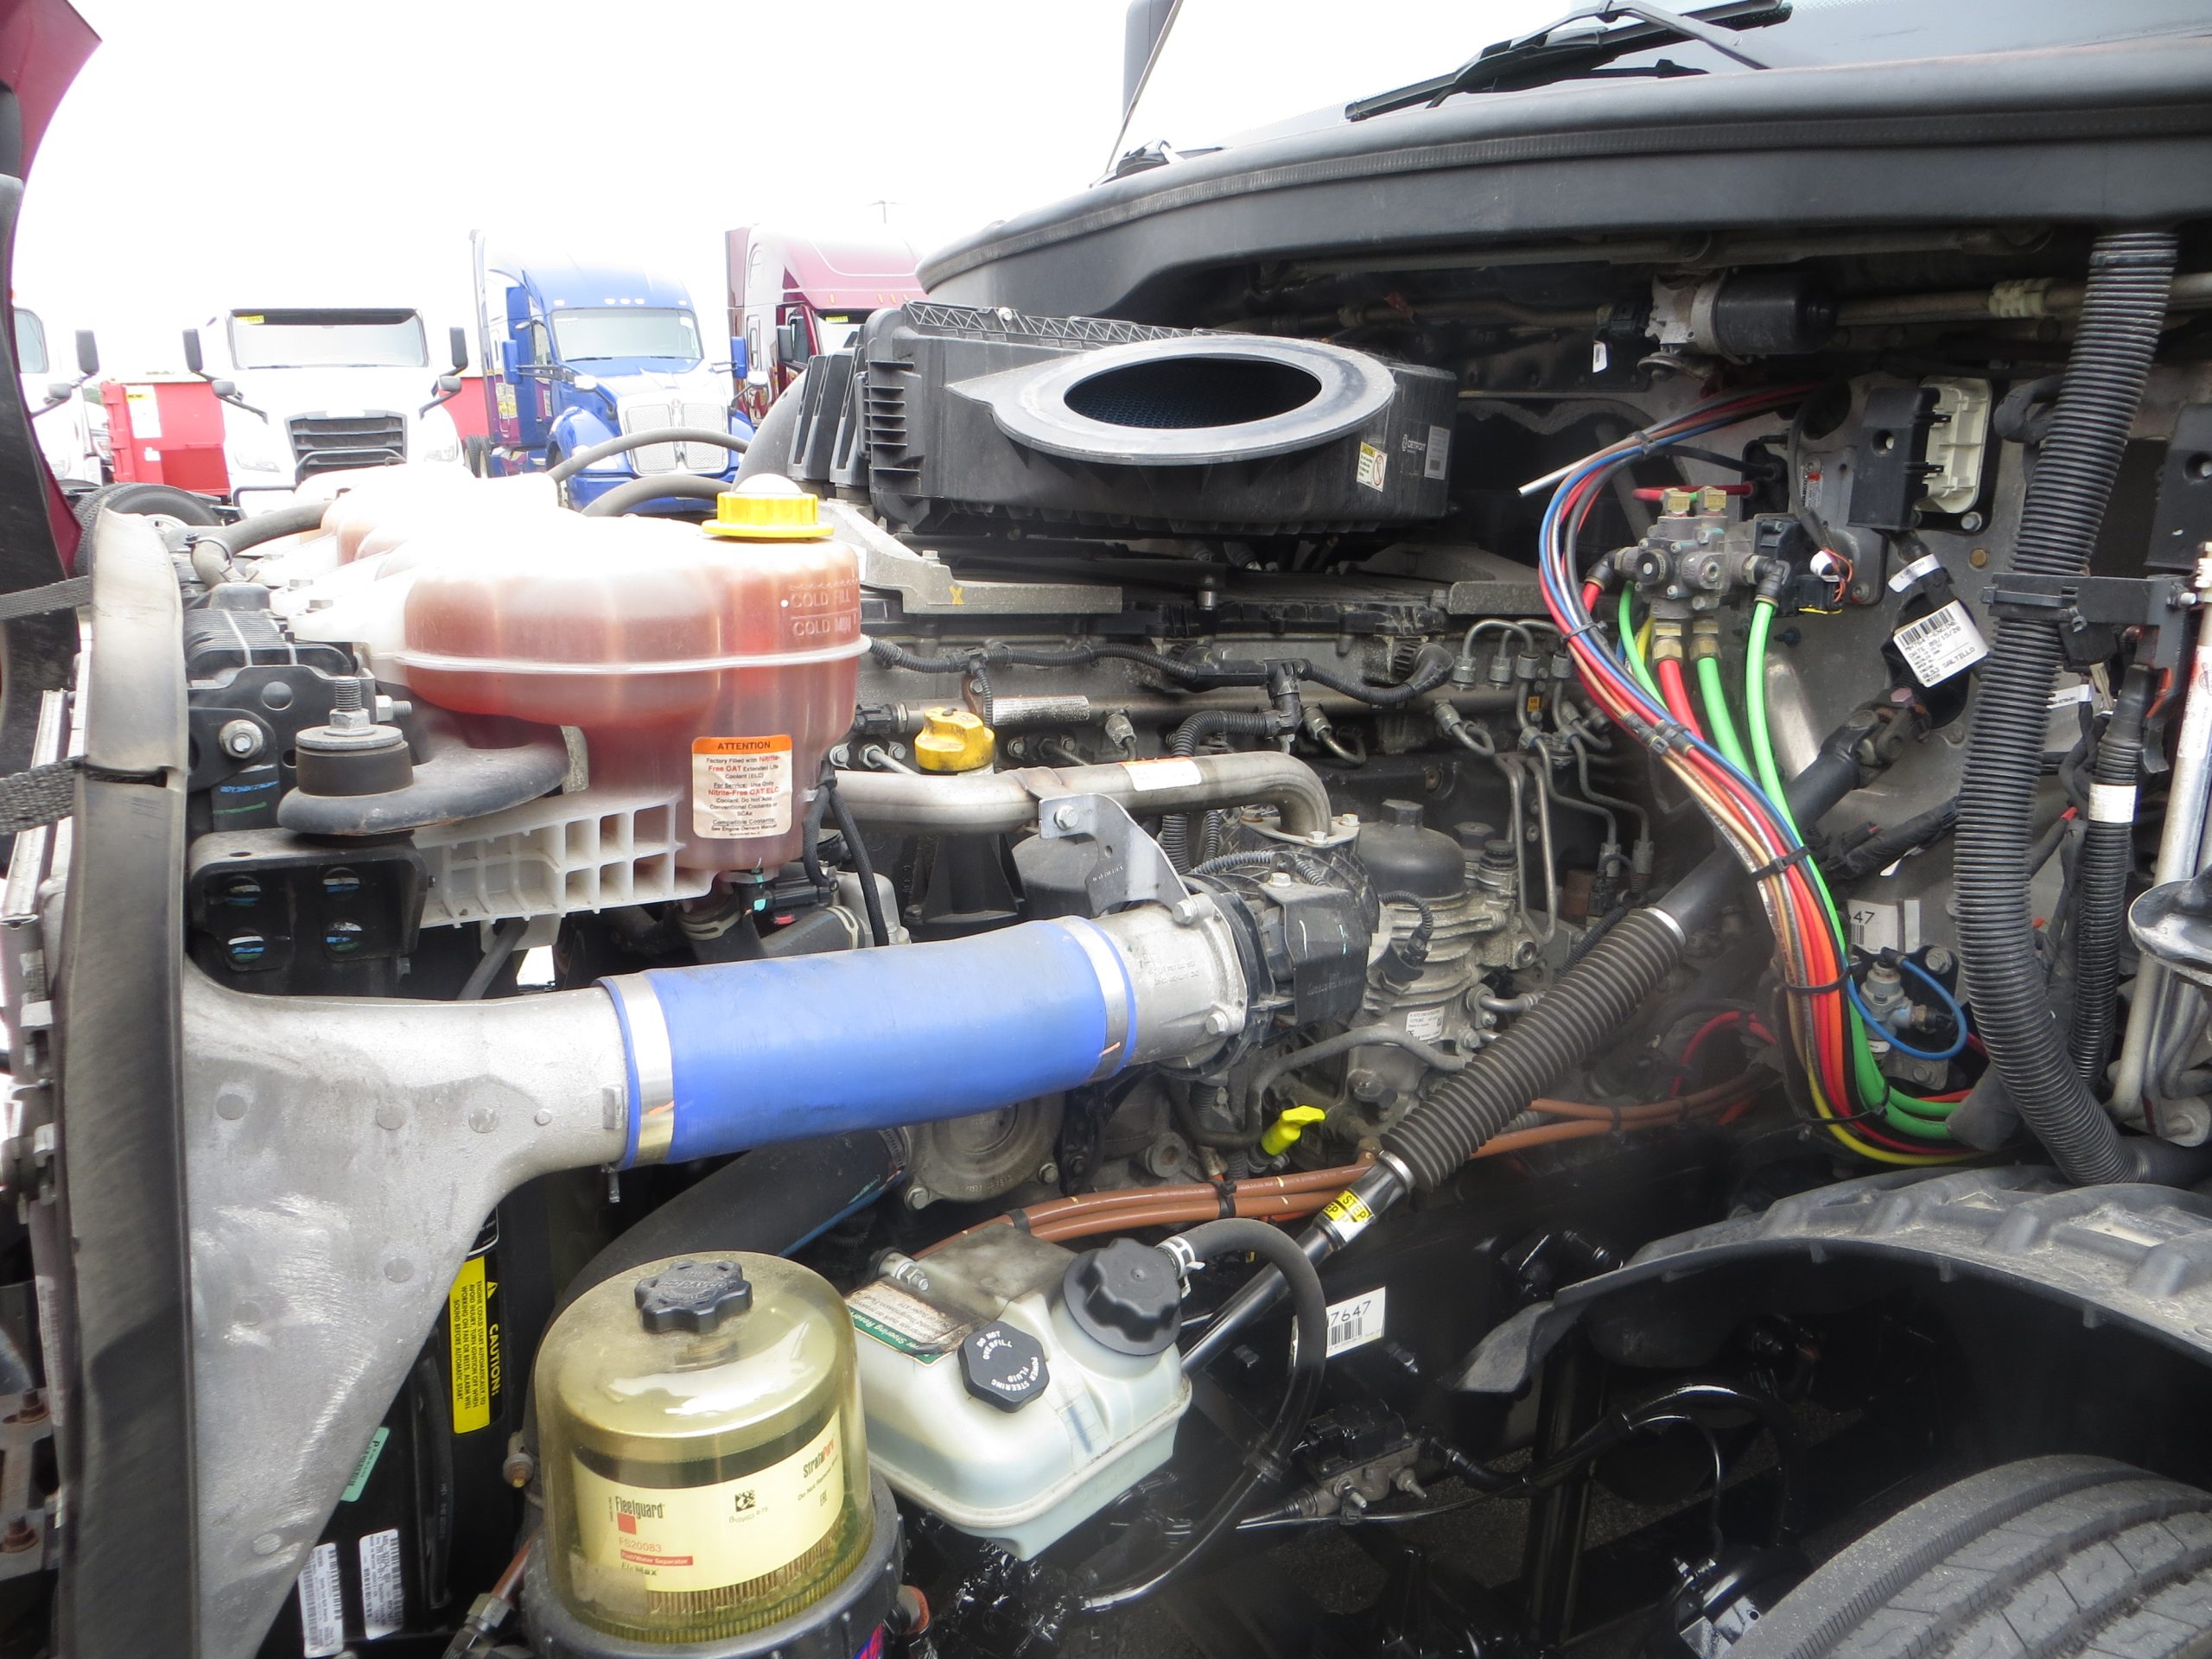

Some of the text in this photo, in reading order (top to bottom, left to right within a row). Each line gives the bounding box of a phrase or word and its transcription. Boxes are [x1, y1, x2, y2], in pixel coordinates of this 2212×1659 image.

[1407, 440, 1426, 451] DETROIT
[791, 592, 829, 608] COLD
[793, 619, 830, 636] COLD
[717, 741, 771, 750] ATTENTION
[1853, 911, 1876, 925] 47
[461, 1318, 468, 1329] ON
[874, 1325, 907, 1344] Steering
[976, 1330, 1001, 1347] DO NOT
[463, 1344, 469, 1353] OR
[983, 1340, 1014, 1360] OVERFILL
[489, 1323, 501, 1397] CAUTION:
[991, 1357, 1039, 1392] POWER STEERING
[1007, 1366, 1029, 1382] FLUID
[615, 1496, 664, 1519] Fleetguard
[619, 1537, 662, 1553] FS20083
